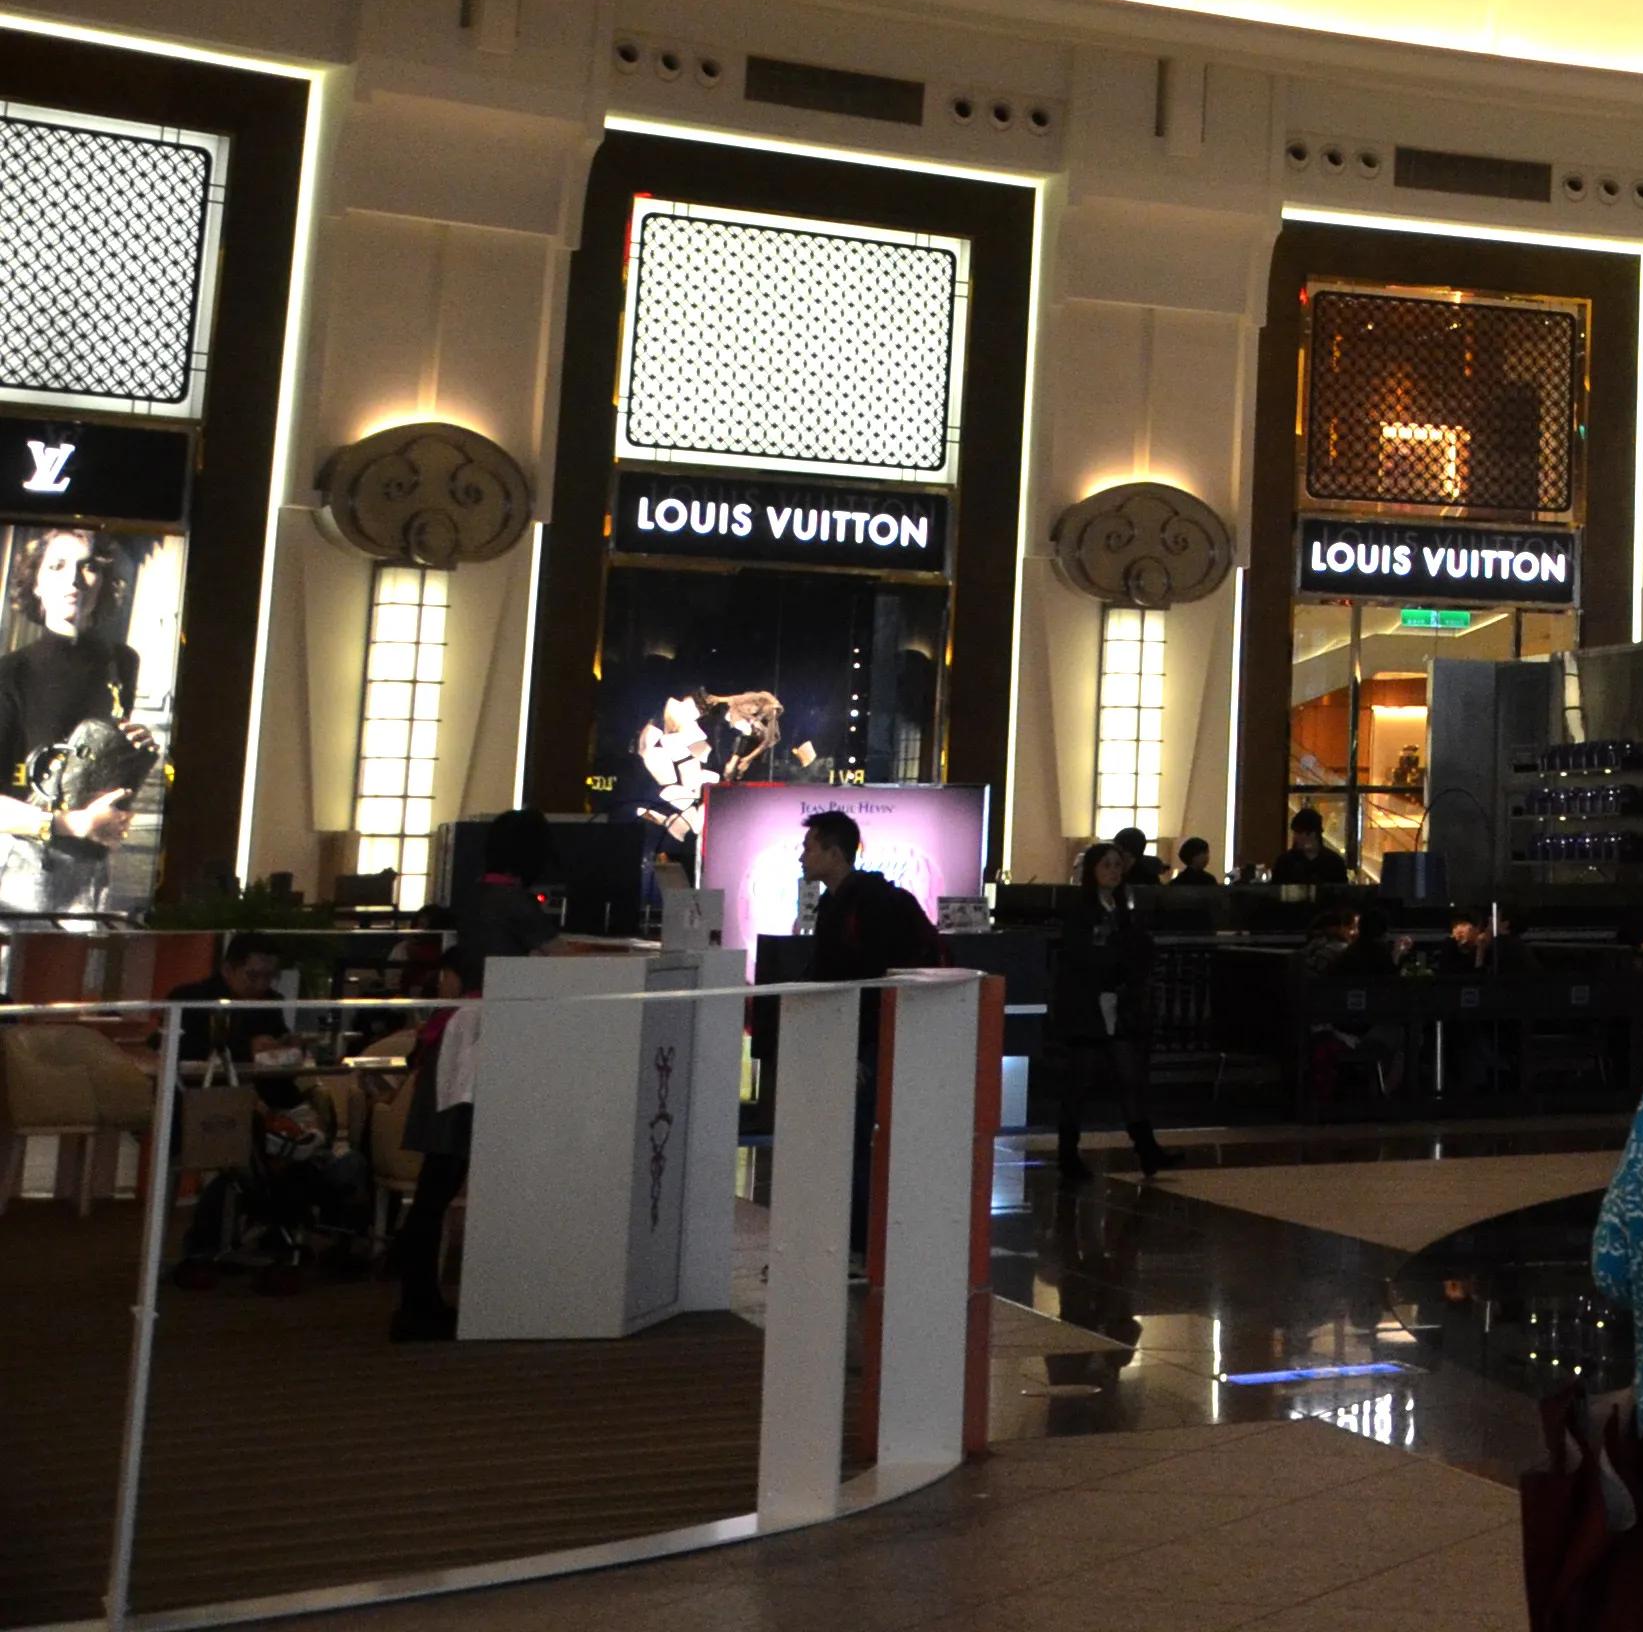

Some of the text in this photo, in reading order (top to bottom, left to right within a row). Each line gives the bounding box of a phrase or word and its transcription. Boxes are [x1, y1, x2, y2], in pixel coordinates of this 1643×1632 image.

[637, 496, 928, 548] LOUIS VUITTON
[1311, 541, 1566, 583] LOUIS VUITTON
